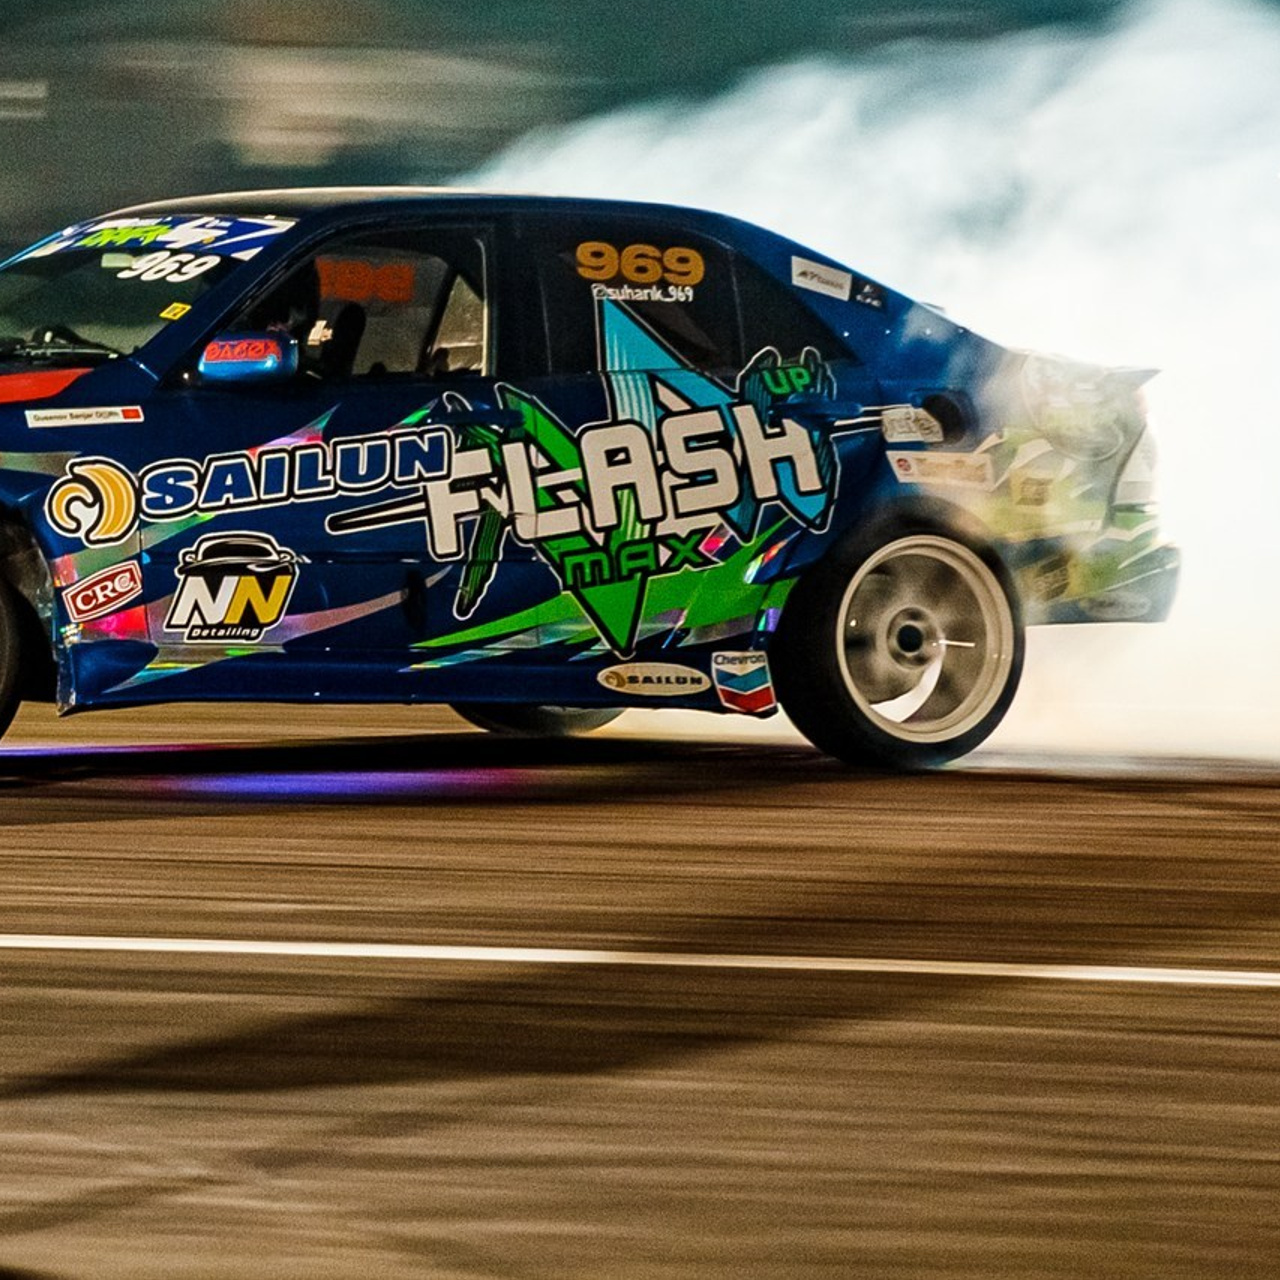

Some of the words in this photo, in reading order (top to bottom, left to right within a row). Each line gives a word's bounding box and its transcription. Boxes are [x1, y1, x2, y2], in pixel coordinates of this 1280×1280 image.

[116, 250, 221, 283] 969
[575, 241, 705, 286] 969
[763, 367, 811, 395] UP
[143, 432, 450, 513] SAILUN
[428, 404, 822, 555] FLASH
[563, 532, 709, 588] MAX
[75, 572, 135, 611] CRC
[190, 626, 260, 639] Detailing
[714, 654, 766, 666] Chevron
[626, 674, 703, 686] SAILUN
